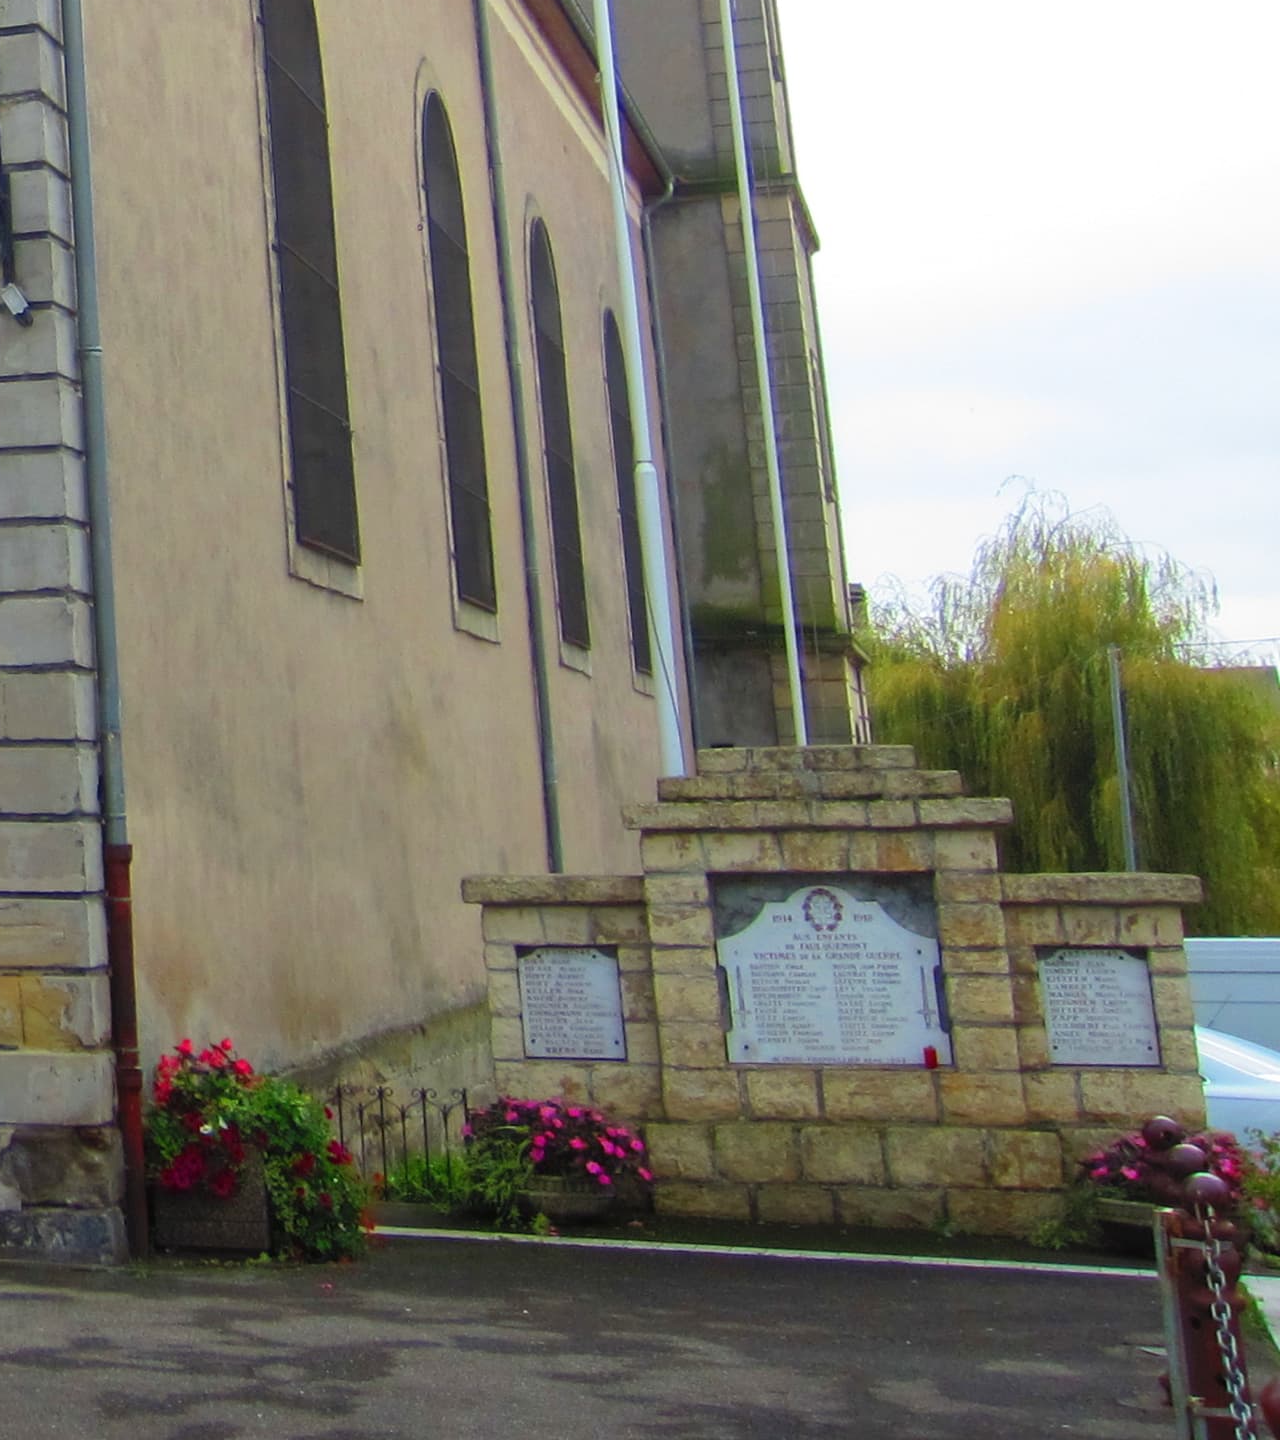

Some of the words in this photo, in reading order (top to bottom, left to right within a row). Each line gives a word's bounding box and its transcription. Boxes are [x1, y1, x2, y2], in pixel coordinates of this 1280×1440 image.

[772, 915, 792, 923] 1914
[753, 952, 795, 960] VICTIMES
[825, 952, 860, 960] GRANDE
[865, 952, 902, 960] GUERRE
